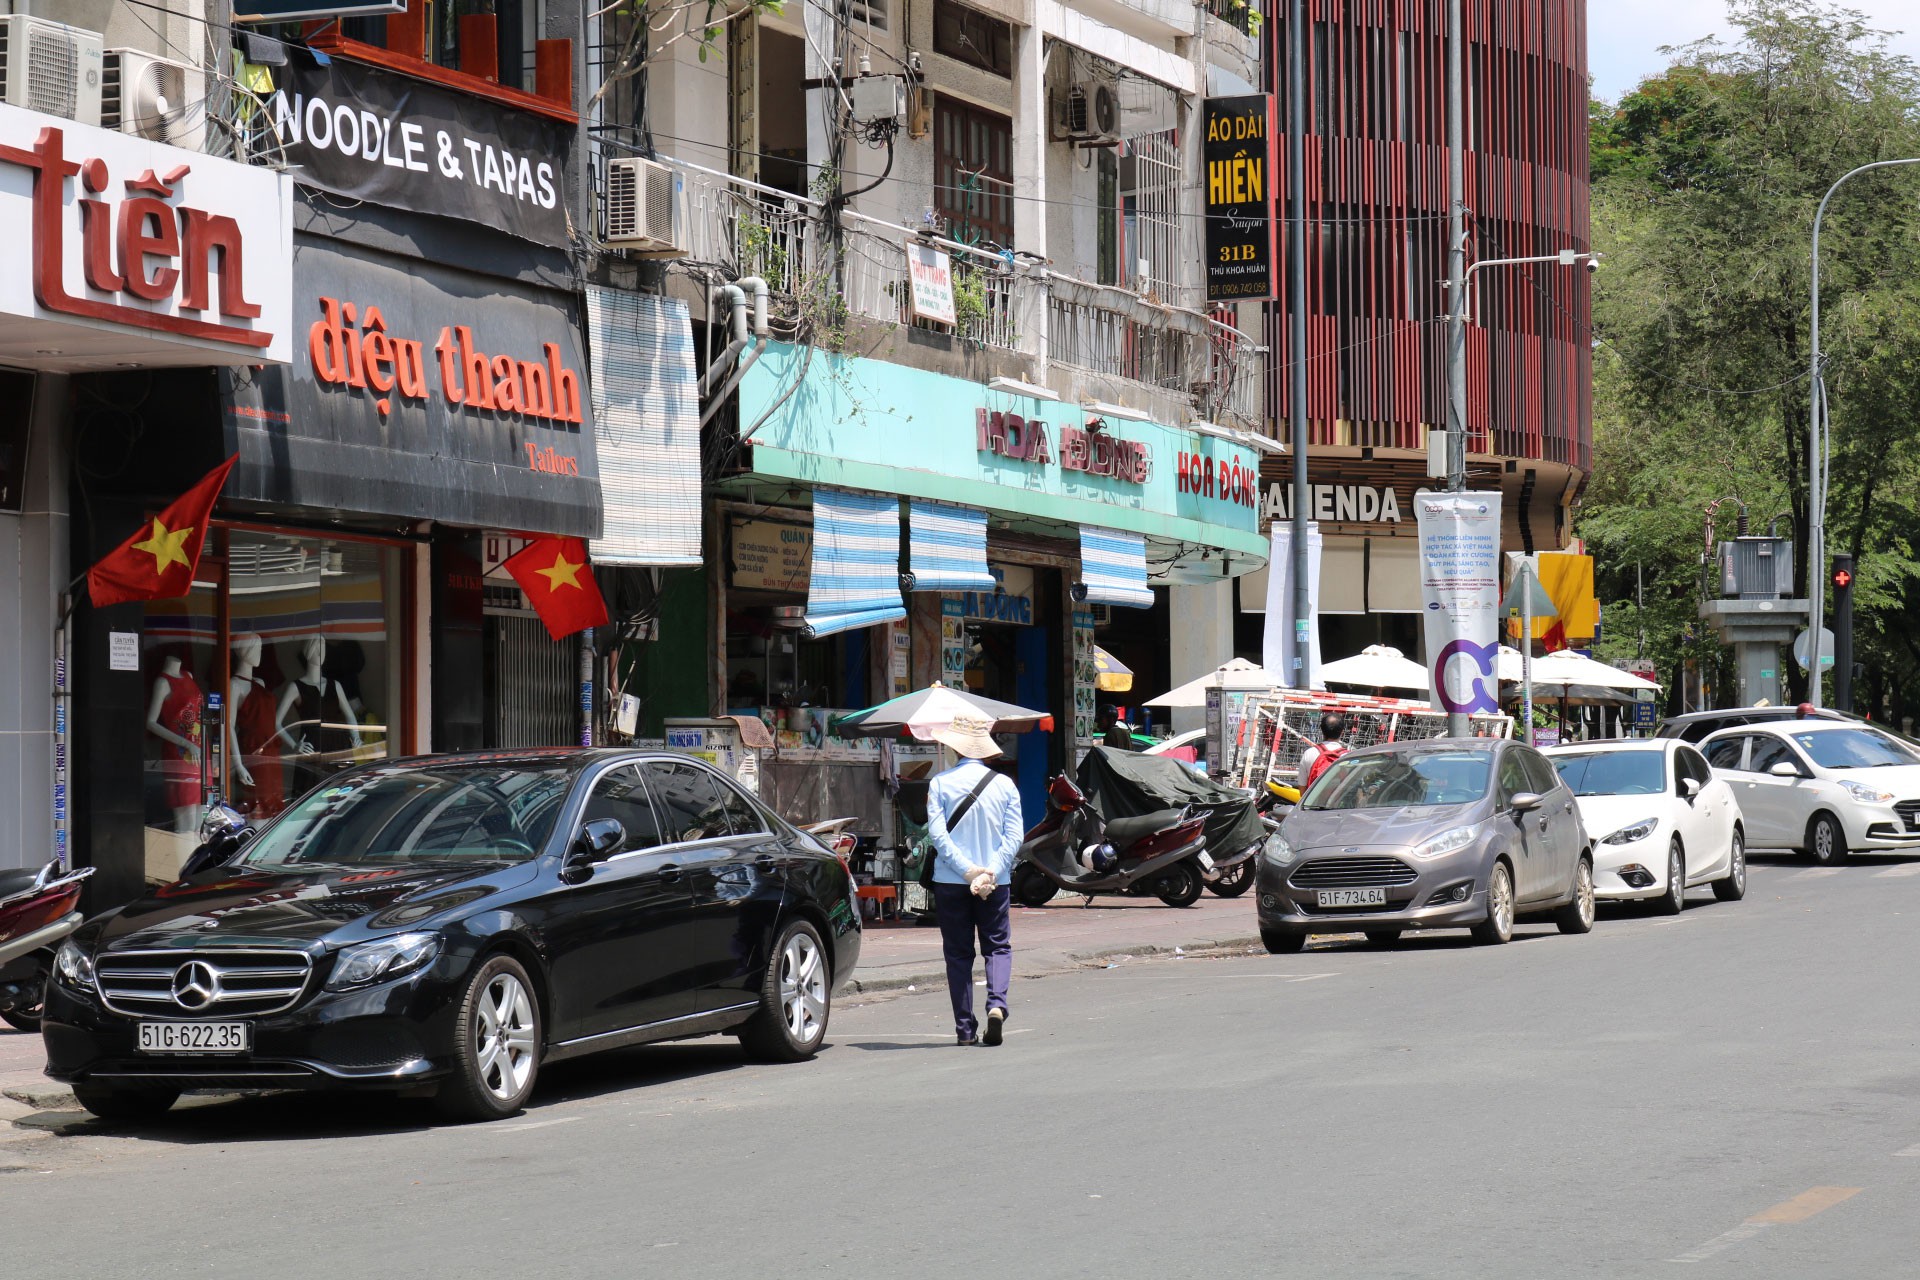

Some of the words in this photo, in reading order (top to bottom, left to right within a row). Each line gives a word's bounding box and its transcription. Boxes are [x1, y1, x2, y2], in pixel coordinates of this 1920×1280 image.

[1208, 112, 1231, 142] ÁO
[1236, 109, 1262, 140] DÀI
[276, 89, 428, 172] NOODLE
[437, 130, 463, 180] &
[463, 138, 556, 209] TAPAS
[1209, 149, 1262, 205] HIỀN
[1222, 208, 1263, 233] Saigon
[0, 127, 273, 347] tiến
[1220, 244, 1256, 262] 31B
[1210, 264, 1224, 276] THỦ
[1226, 266, 1245, 275] KHOA
[1246, 262, 1266, 273] HUÂN
[1222, 284, 1239, 295] 0906
[1240, 282, 1252, 294] 742
[1253, 282, 1266, 293] 058
[310, 297, 429, 415] diệu
[435, 326, 584, 423] thanh
[976, 407, 1056, 465] HOA
[525, 443, 578, 477] Tailors
[1178, 451, 1214, 498] HOA
[1219, 455, 1256, 509] ĐÔNG
[781, 528, 805, 544] QUÁN
[763, 576, 775, 586] BÚN
[1320, 890, 1383, 905] 51F-734.64
[142, 1025, 241, 1047] 51G-622.35
